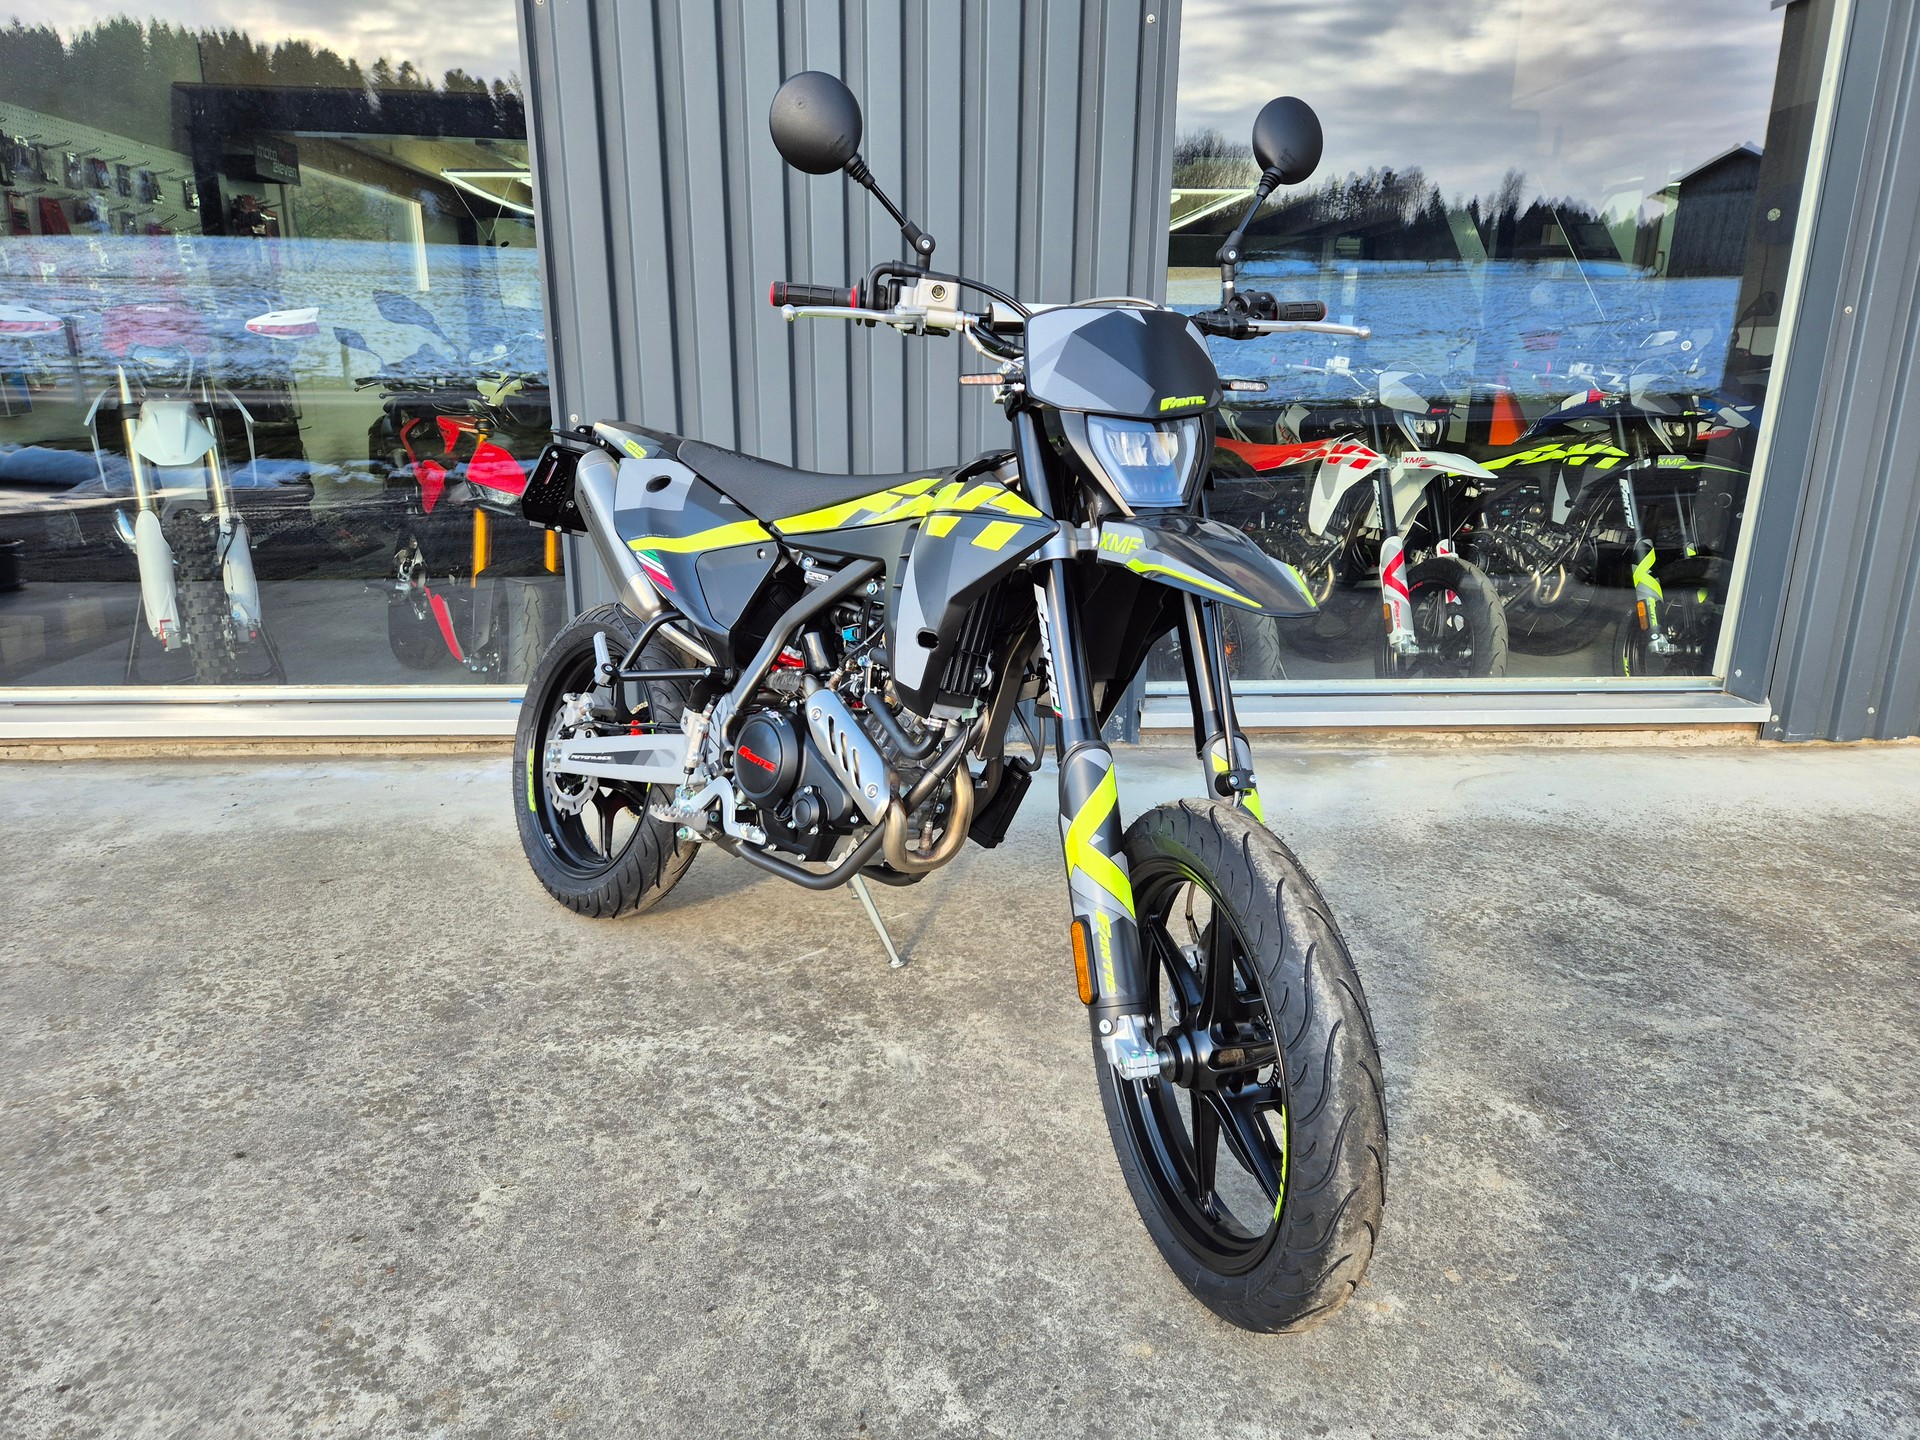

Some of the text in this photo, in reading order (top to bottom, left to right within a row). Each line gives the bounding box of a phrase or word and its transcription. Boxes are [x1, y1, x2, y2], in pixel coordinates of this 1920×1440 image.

[257, 145, 277, 161] moto
[273, 159, 298, 179] eleven
[1160, 395, 1206, 411] FANTIC
[1658, 457, 1688, 466] XMF
[1099, 531, 1144, 555] XMF
[1095, 908, 1118, 994] FANTIC
